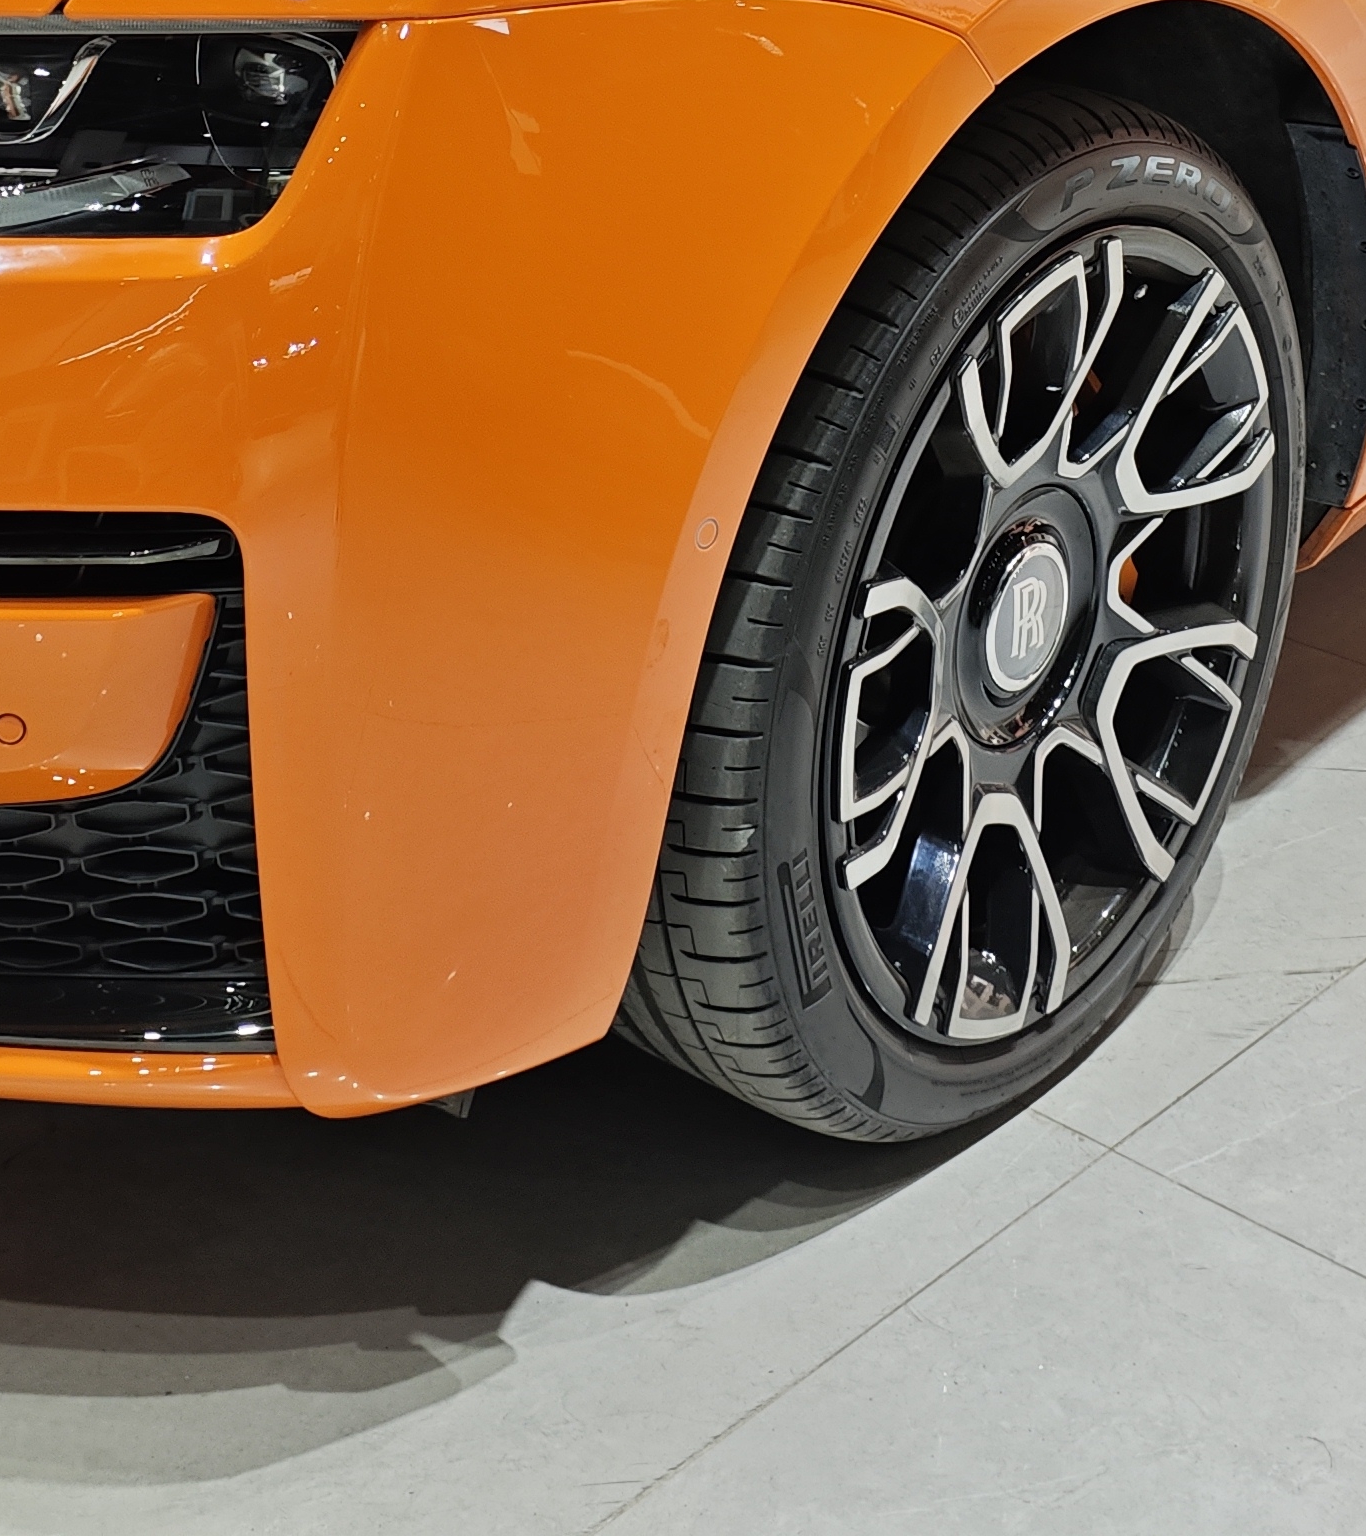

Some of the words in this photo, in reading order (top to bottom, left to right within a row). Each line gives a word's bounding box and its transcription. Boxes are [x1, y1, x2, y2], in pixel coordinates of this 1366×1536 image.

[1060, 166, 1096, 213] P
[1105, 154, 1234, 214] ZERO
[776, 847, 834, 1011] PIRELLI
